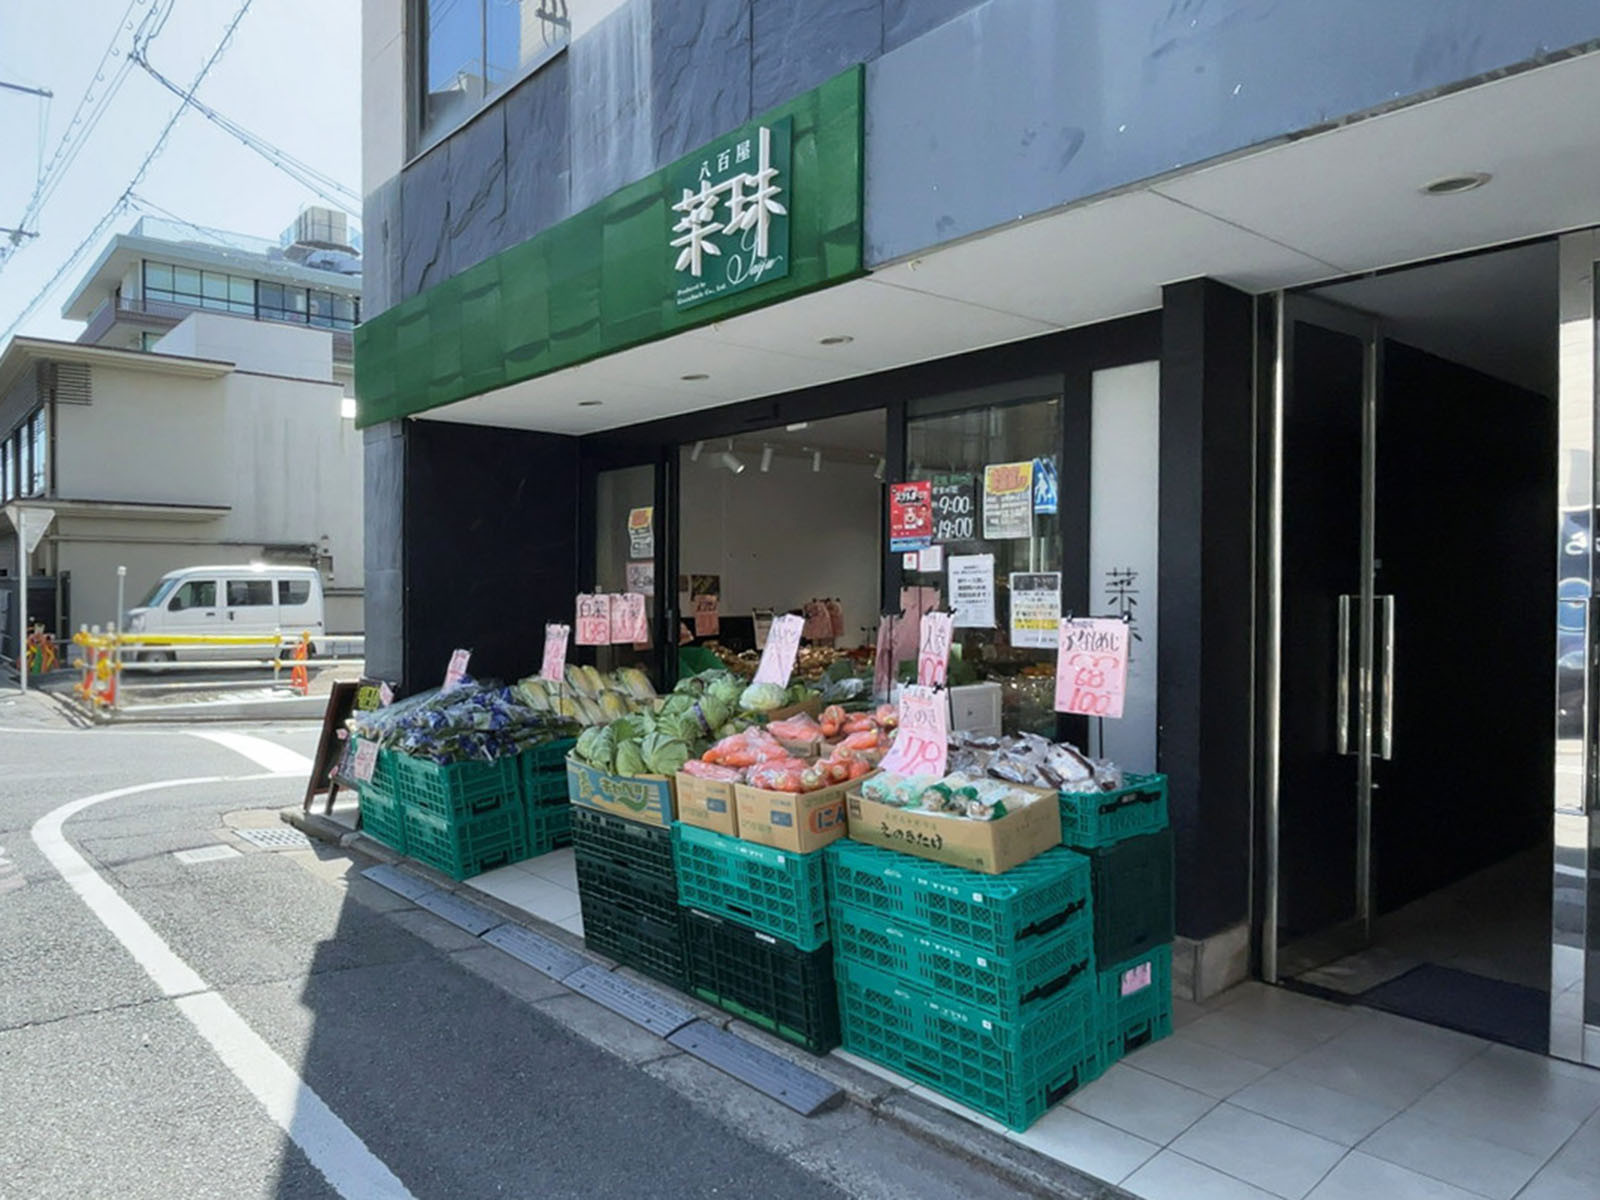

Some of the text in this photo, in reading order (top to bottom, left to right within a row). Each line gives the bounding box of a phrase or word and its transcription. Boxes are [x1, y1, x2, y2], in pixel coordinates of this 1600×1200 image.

[699, 139, 751, 180] 八百屋
[669, 126, 787, 277] 菜珠
[939, 496, 970, 515] 9:00
[937, 517, 973, 539] 19:00
